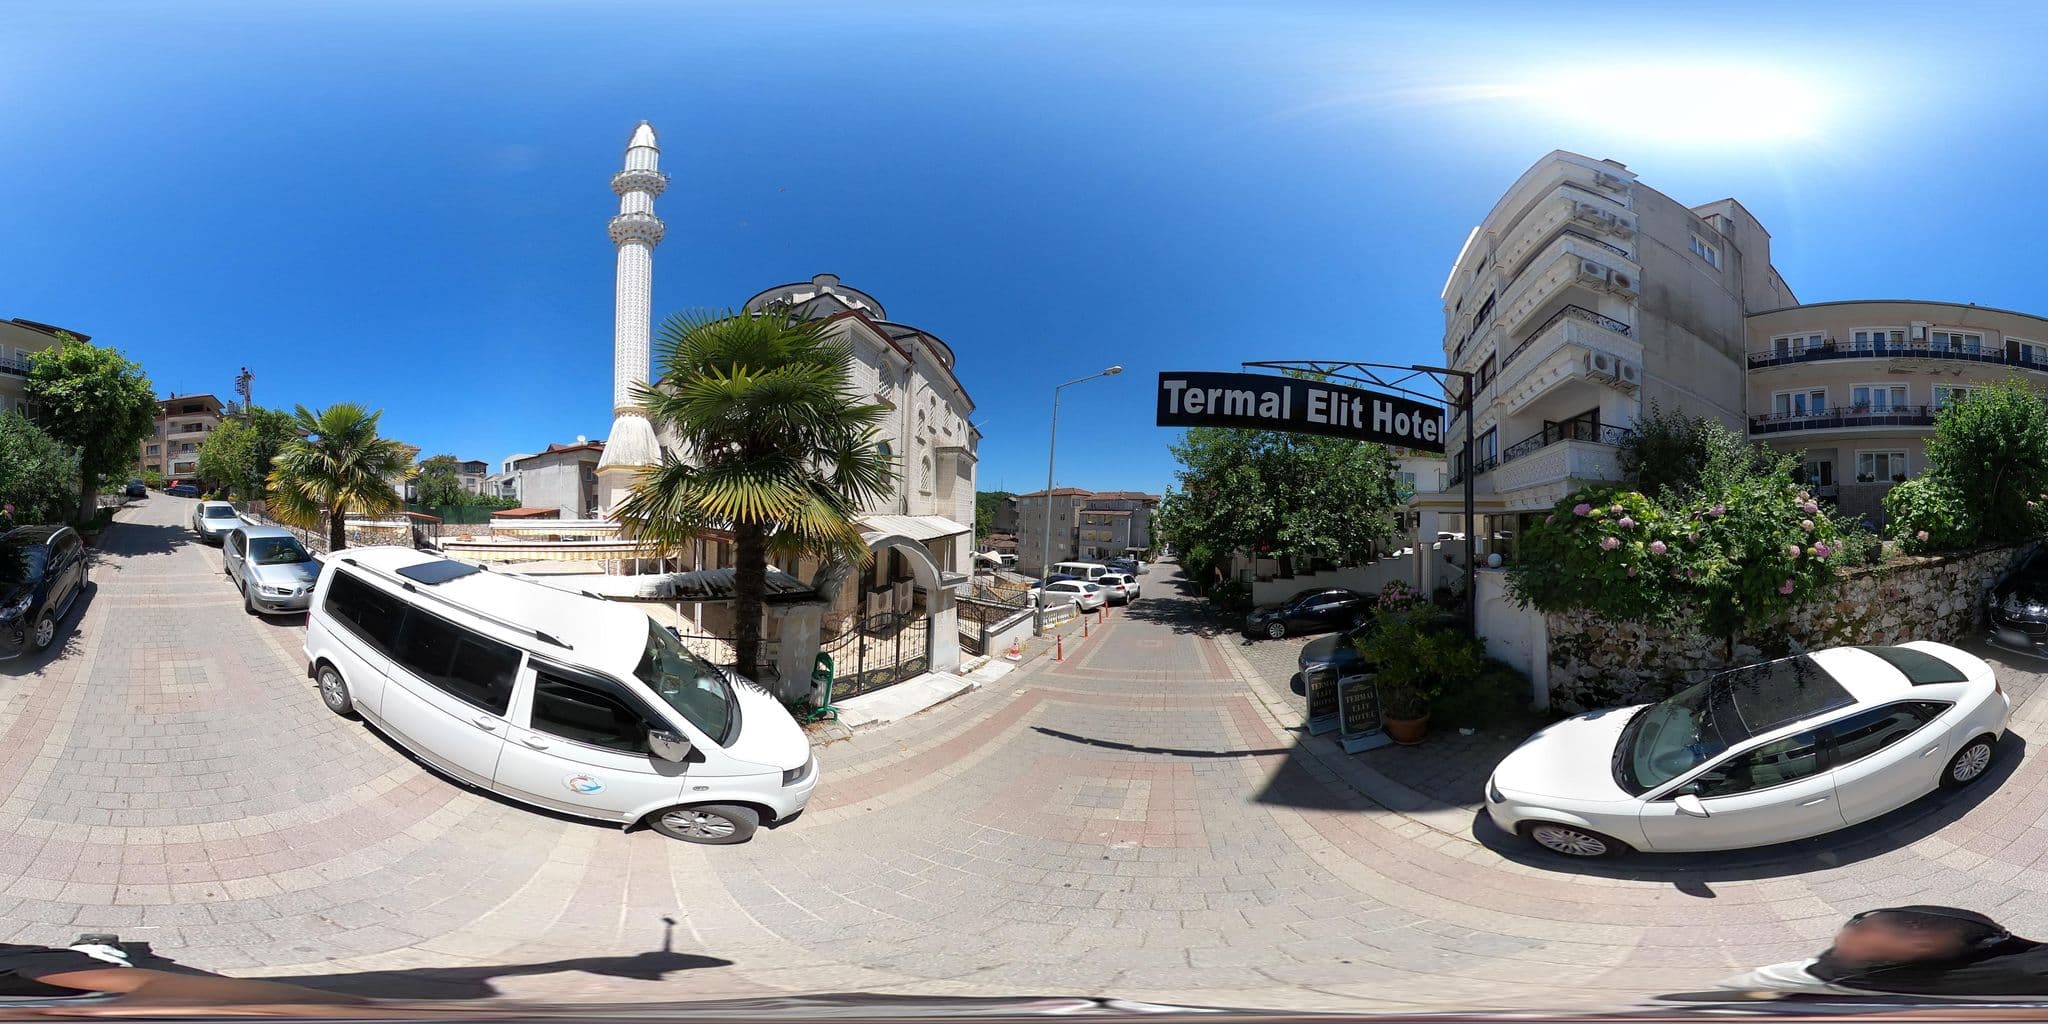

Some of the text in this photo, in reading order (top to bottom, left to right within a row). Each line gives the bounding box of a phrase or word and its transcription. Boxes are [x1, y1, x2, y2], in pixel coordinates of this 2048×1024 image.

[1163, 380, 1444, 444] Termal Elit Hotel
